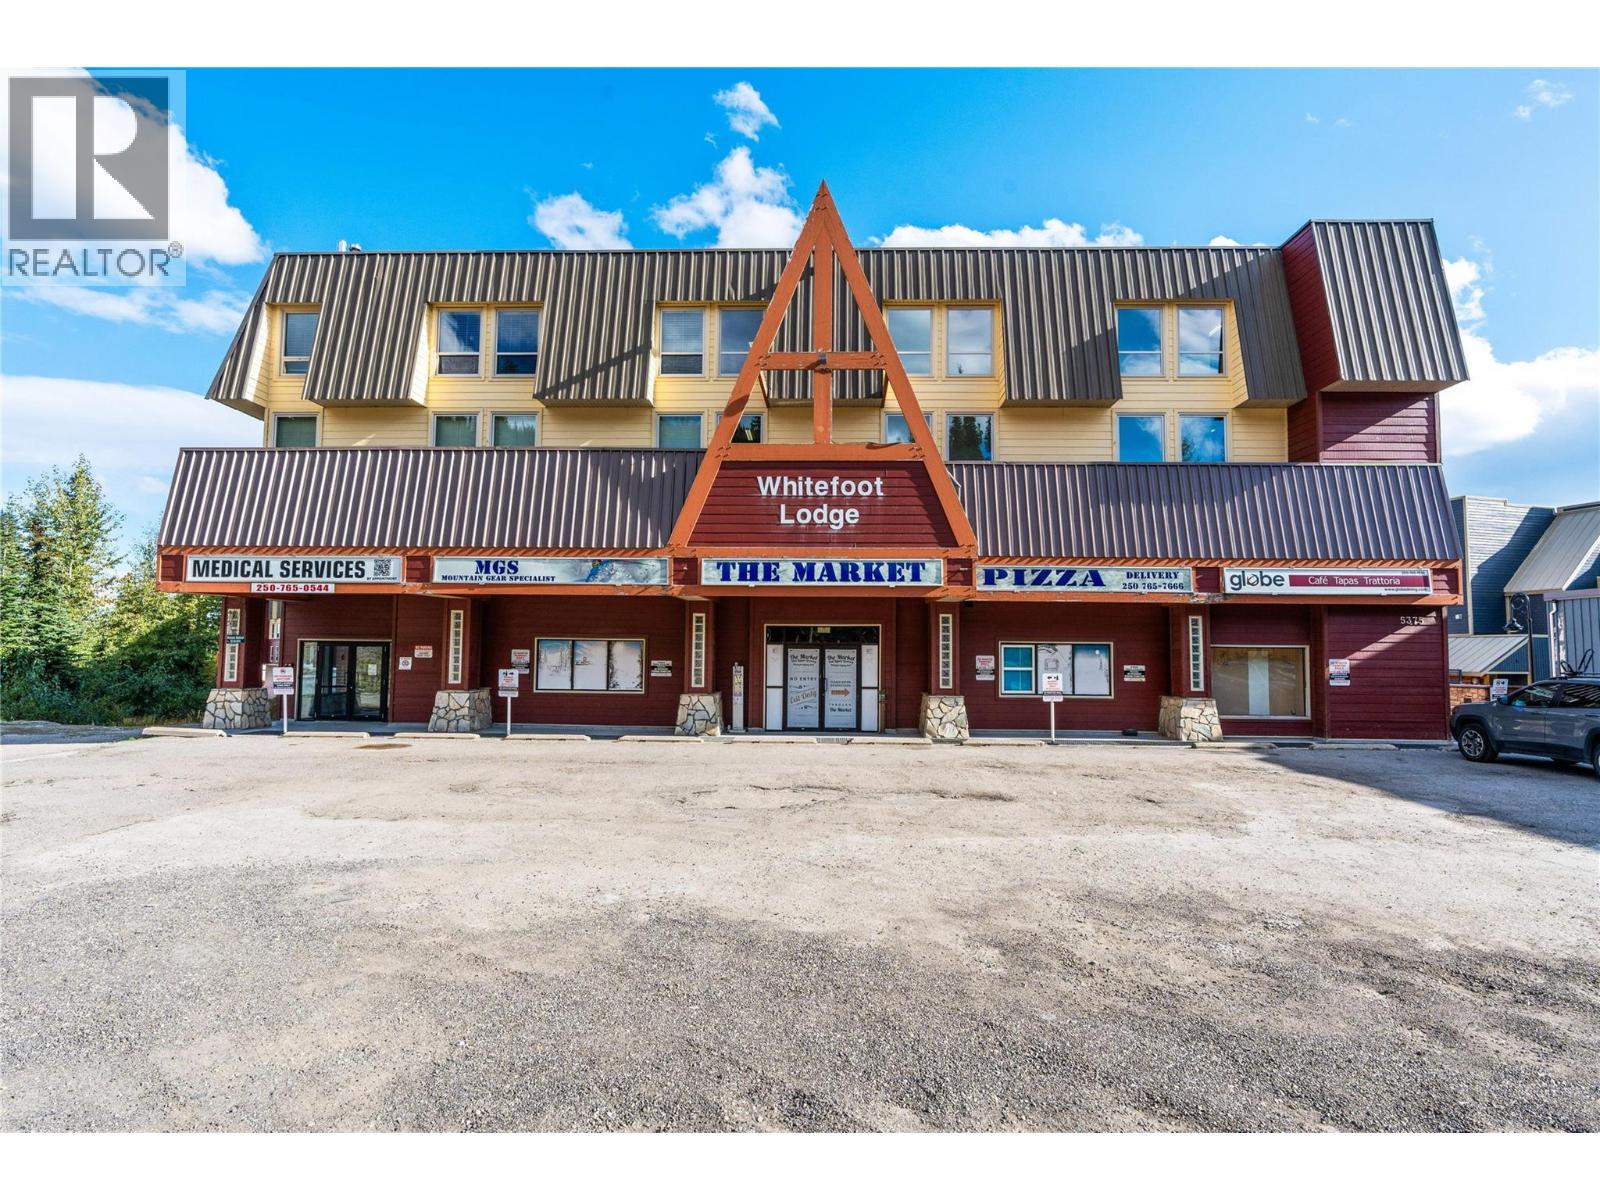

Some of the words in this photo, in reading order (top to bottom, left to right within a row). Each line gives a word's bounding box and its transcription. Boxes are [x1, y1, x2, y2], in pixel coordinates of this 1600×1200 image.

[757, 476, 884, 497] Whitefoot
[780, 503, 860, 530] Lodge
[192, 559, 273, 578] MEDICAL
[279, 560, 366, 579] SERVICES
[475, 560, 519, 575] MGS
[717, 562, 780, 582] THE
[792, 562, 925, 582] MARKET
[1126, 571, 1180, 580] DELIVERY
[982, 568, 1106, 587] PIZZA
[1122, 582, 1139, 590] 250
[1142, 582, 1184, 590] 765-7666
[1230, 571, 1285, 591] globe
[1308, 576, 1329, 585] Café
[1335, 576, 1359, 587] Tapas
[1365, 576, 1401, 585] Trattoria
[256, 584, 329, 592] 250-765-0544
[1400, 616, 1425, 625] 5375
